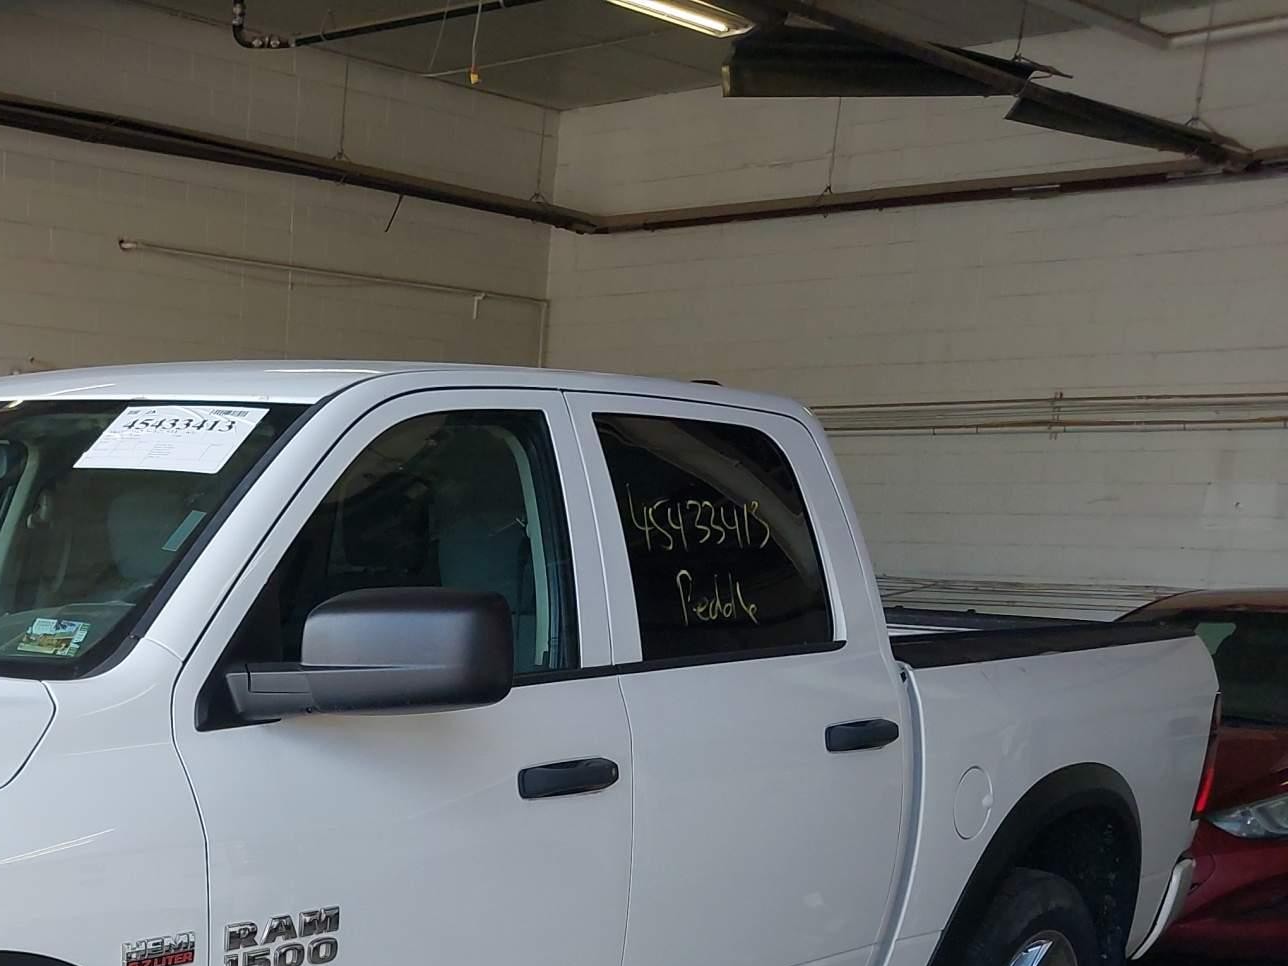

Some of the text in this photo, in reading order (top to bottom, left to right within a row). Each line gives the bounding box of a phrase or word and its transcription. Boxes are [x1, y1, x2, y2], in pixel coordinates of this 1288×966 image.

[123, 419, 236, 432] 45433413
[626, 483, 770, 552] 45433413
[123, 932, 195, 961] HEMI
[225, 906, 340, 952] RAM
